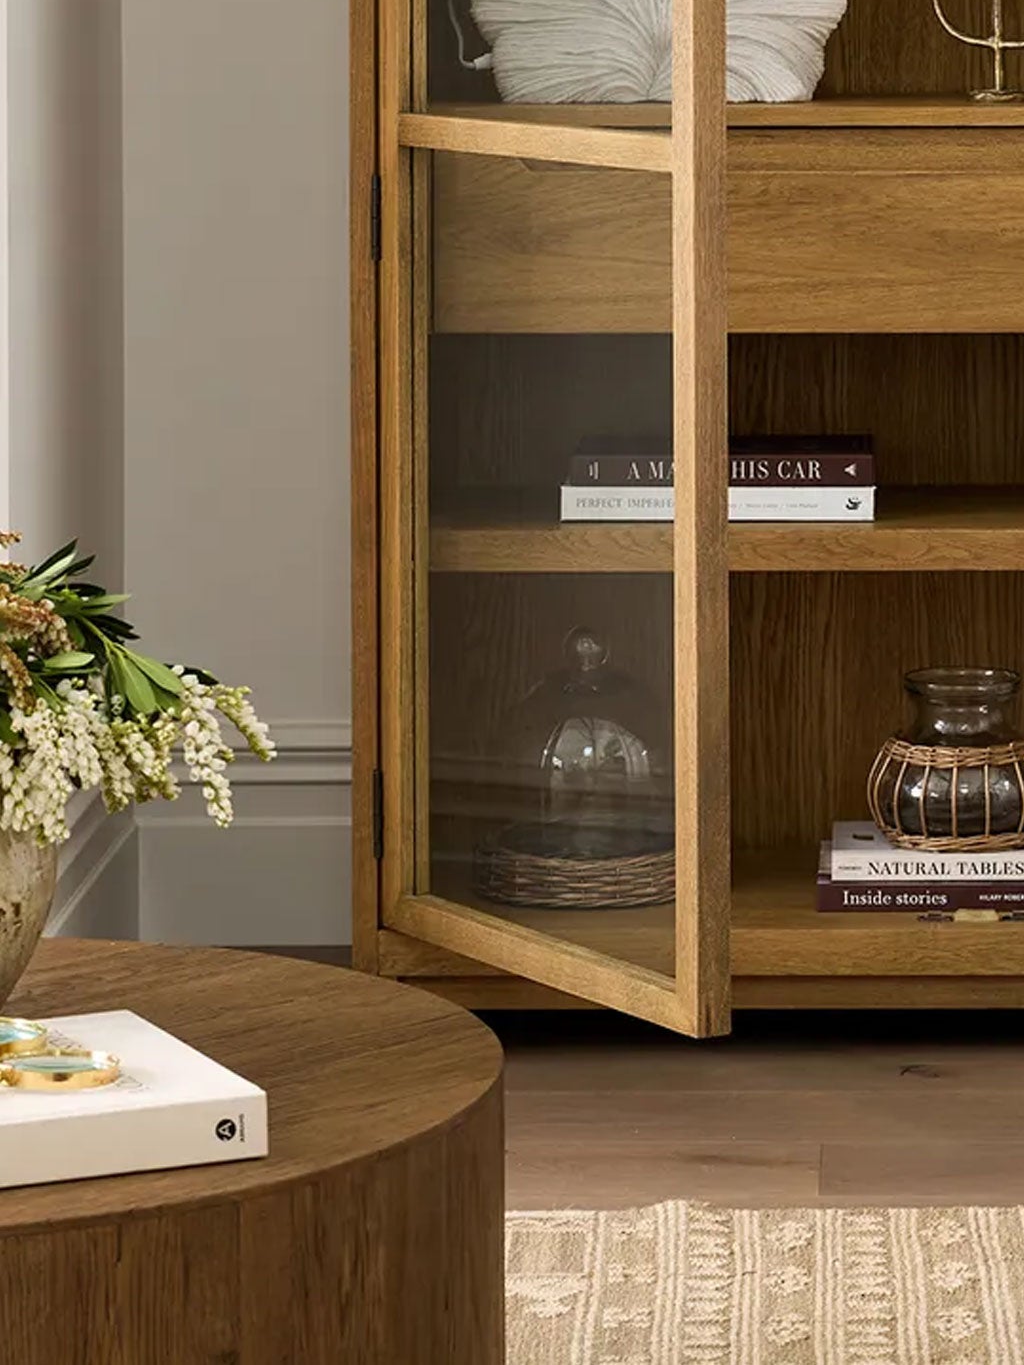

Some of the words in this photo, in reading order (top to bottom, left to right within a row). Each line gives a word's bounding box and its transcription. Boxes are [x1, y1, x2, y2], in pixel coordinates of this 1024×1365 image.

[627, 461, 641, 480] A
[731, 460, 770, 480] HIS
[777, 460, 822, 480] CAR
[576, 498, 622, 509] PERFECT
[868, 862, 951, 875] NATURAL
[956, 861, 1024, 875] TABLES
[843, 889, 892, 905] Inside
[895, 889, 948, 905] stories
